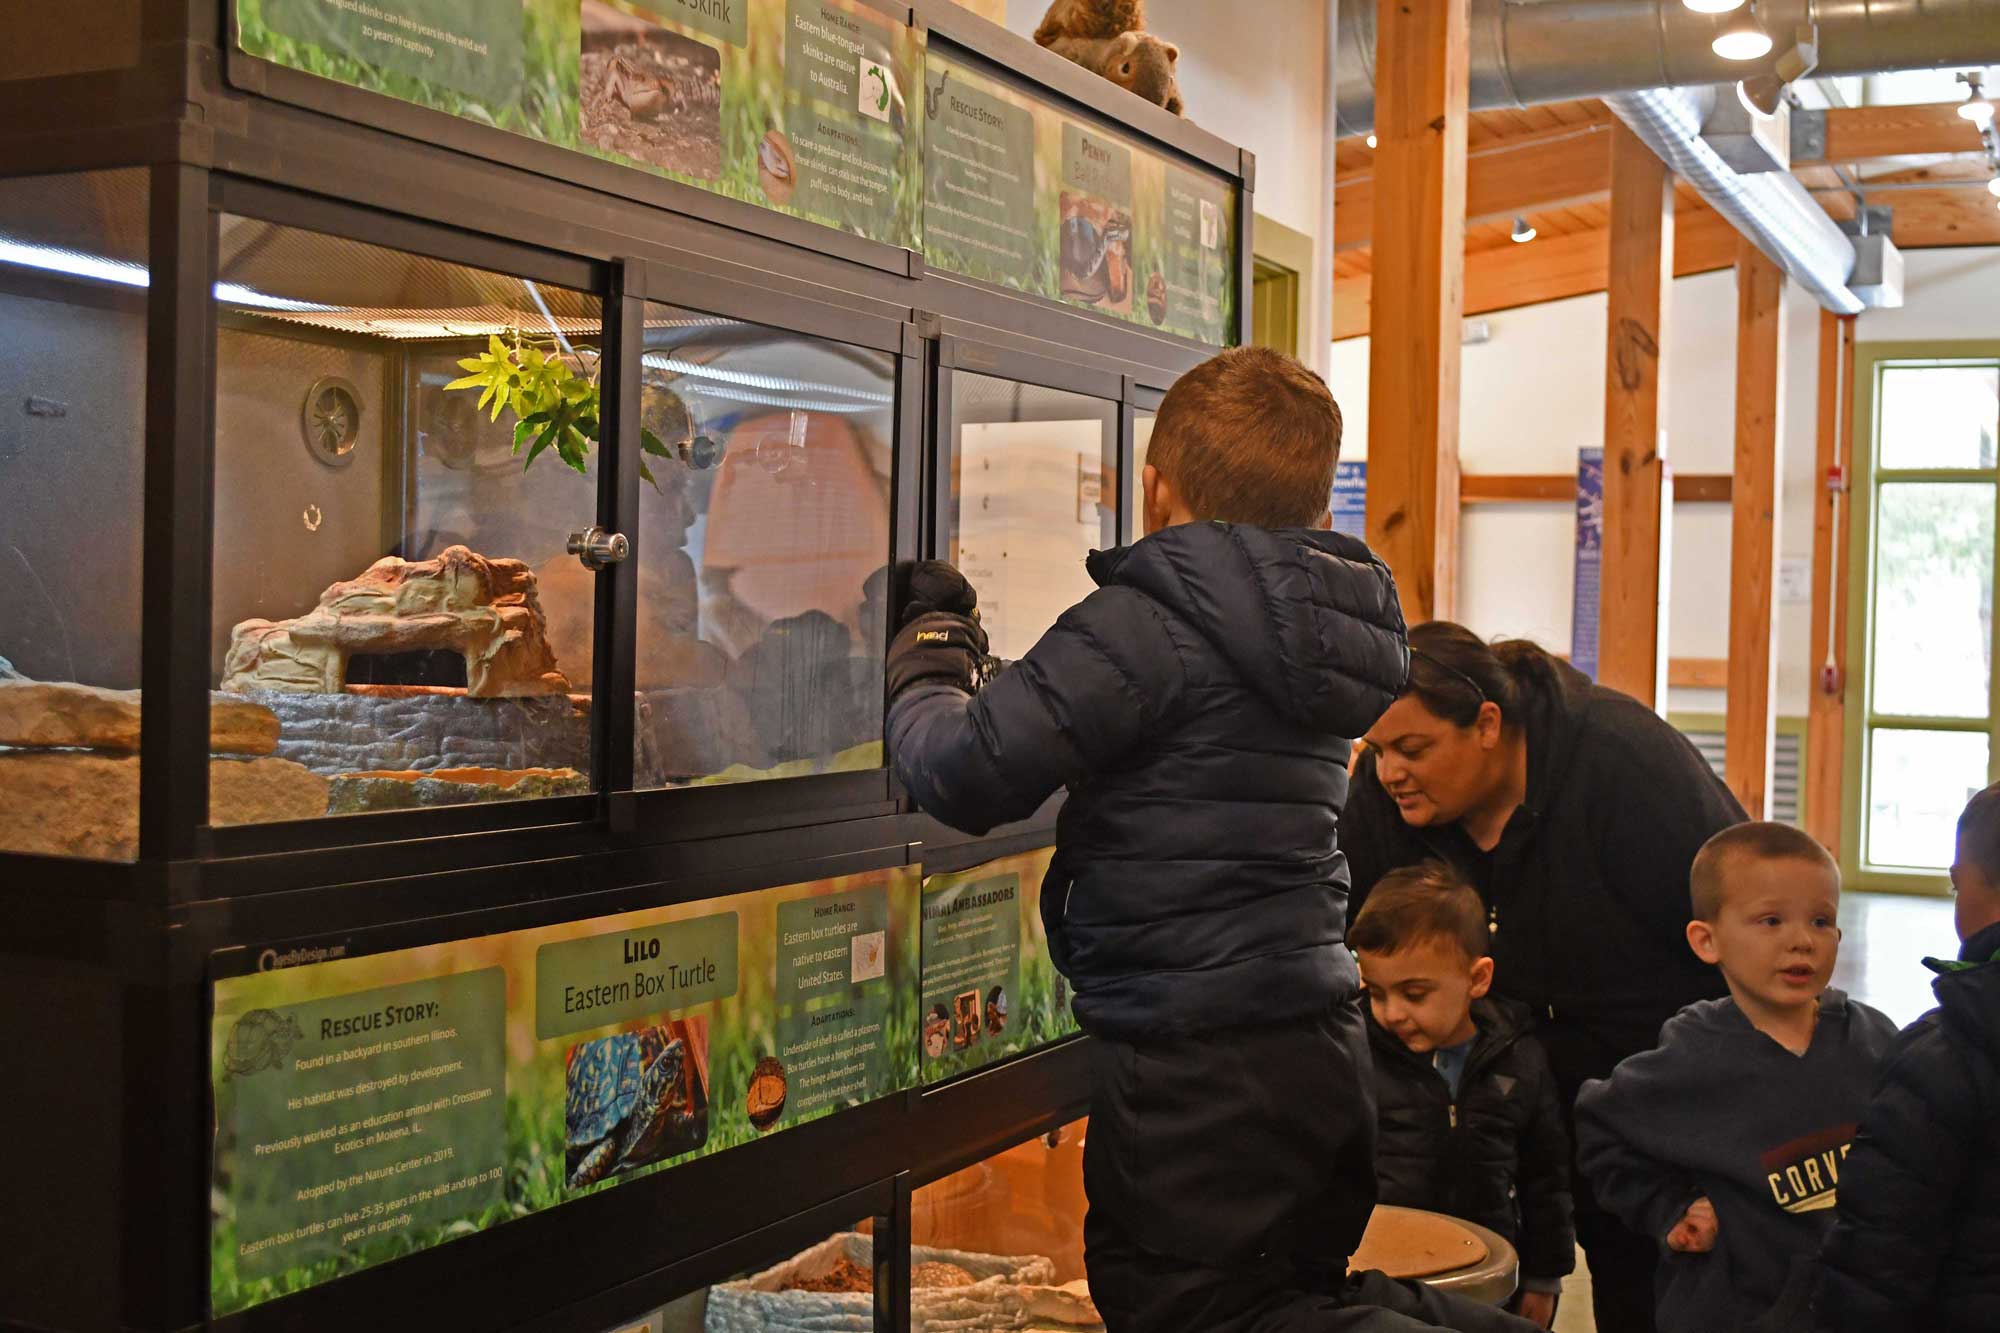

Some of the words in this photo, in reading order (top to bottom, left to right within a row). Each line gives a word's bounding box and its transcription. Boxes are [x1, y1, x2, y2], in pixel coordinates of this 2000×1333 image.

[362, 25, 373, 36] 20
[374, 29, 393, 43] years
[384, 13, 397, 25] can
[398, 15, 411, 30] live
[418, 24, 437, 39] years
[445, 31, 457, 45] the
[458, 36, 473, 50] wild
[473, 42, 487, 55] and
[795, 14, 820, 36] Eastern
[821, 25, 865, 56] blue-tongued
[802, 42, 824, 61] skinks
[824, 54, 835, 66] are
[835, 57, 856, 75] native
[810, 69, 818, 81] to
[818, 72, 849, 95] Australia.
[950, 96, 977, 120] RESCUE
[791, 131, 799, 145] To
[952, 887, 1015, 913] AMBASSADORS
[783, 931, 811, 946] Eastern
[811, 926, 823, 940] box
[823, 921, 847, 938] turtles
[847, 921, 858, 933] are
[623, 937, 661, 965] LILO
[792, 950, 814, 968] native
[815, 950, 823, 962] to
[823, 946, 848, 962] eastern
[564, 981, 630, 1014] Eastern
[634, 971, 665, 998] Box
[668, 957, 716, 991] Turtle
[798, 971, 822, 989] United
[321, 1012, 382, 1041] RESCUE
[385, 1001, 440, 1028] STORY:
[811, 1008, 856, 1027] ADAPTATIONS:
[295, 1055, 324, 1072] Found
[325, 1055, 335, 1066] in
[335, 1055, 342, 1063] a
[343, 1042, 382, 1061] backyard
[383, 1042, 392, 1052] in
[392, 1033, 430, 1050] southern
[431, 1027, 459, 1042] Illinois.
[288, 1098, 303, 1111] His
[304, 1088, 336, 1107] habitat
[336, 1085, 354, 1098] was
[355, 1074, 398, 1095] destroyed
[398, 1072, 409, 1086] by
[411, 1060, 465, 1082] development.
[255, 1135, 302, 1157] Previously
[303, 1125, 338, 1144] worked
[338, 1124, 349, 1135] as
[350, 1121, 361, 1132] an
[363, 1110, 404, 1129] education
[405, 1101, 433, 1118] animal
[433, 1096, 452, 1110] with
[452, 1087, 492, 1105] Crosstown
[335, 1137, 364, 1154] Exotics
[366, 1134, 374, 1146] in
[376, 1126, 411, 1142] Mokena,
[297, 1180, 335, 1201] Adopted
[336, 1180, 347, 1192] by
[349, 1174, 363, 1186] the
[364, 1166, 394, 1181] Nature
[395, 1158, 423, 1174] Center
[424, 1154, 432, 1165] in
[1767, 1143, 1852, 1205] CORV
[240, 1236, 276, 1256] Eastern
[277, 1231, 295, 1245] box
[296, 1221, 325, 1239] turtles
[326, 1217, 343, 1229] can
[343, 1212, 359, 1224] live
[360, 1202, 385, 1219] 25-35
[385, 1196, 408, 1215] years
[409, 1193, 417, 1203] in
[418, 1190, 433, 1200] the
[433, 1182, 450, 1197] wild
[450, 1176, 467, 1190] and
[467, 1175, 478, 1188] up
[478, 1171, 488, 1183] to
[489, 1166, 503, 1180] 100
[342, 1226, 366, 1246] years
[367, 1224, 376, 1236] in
